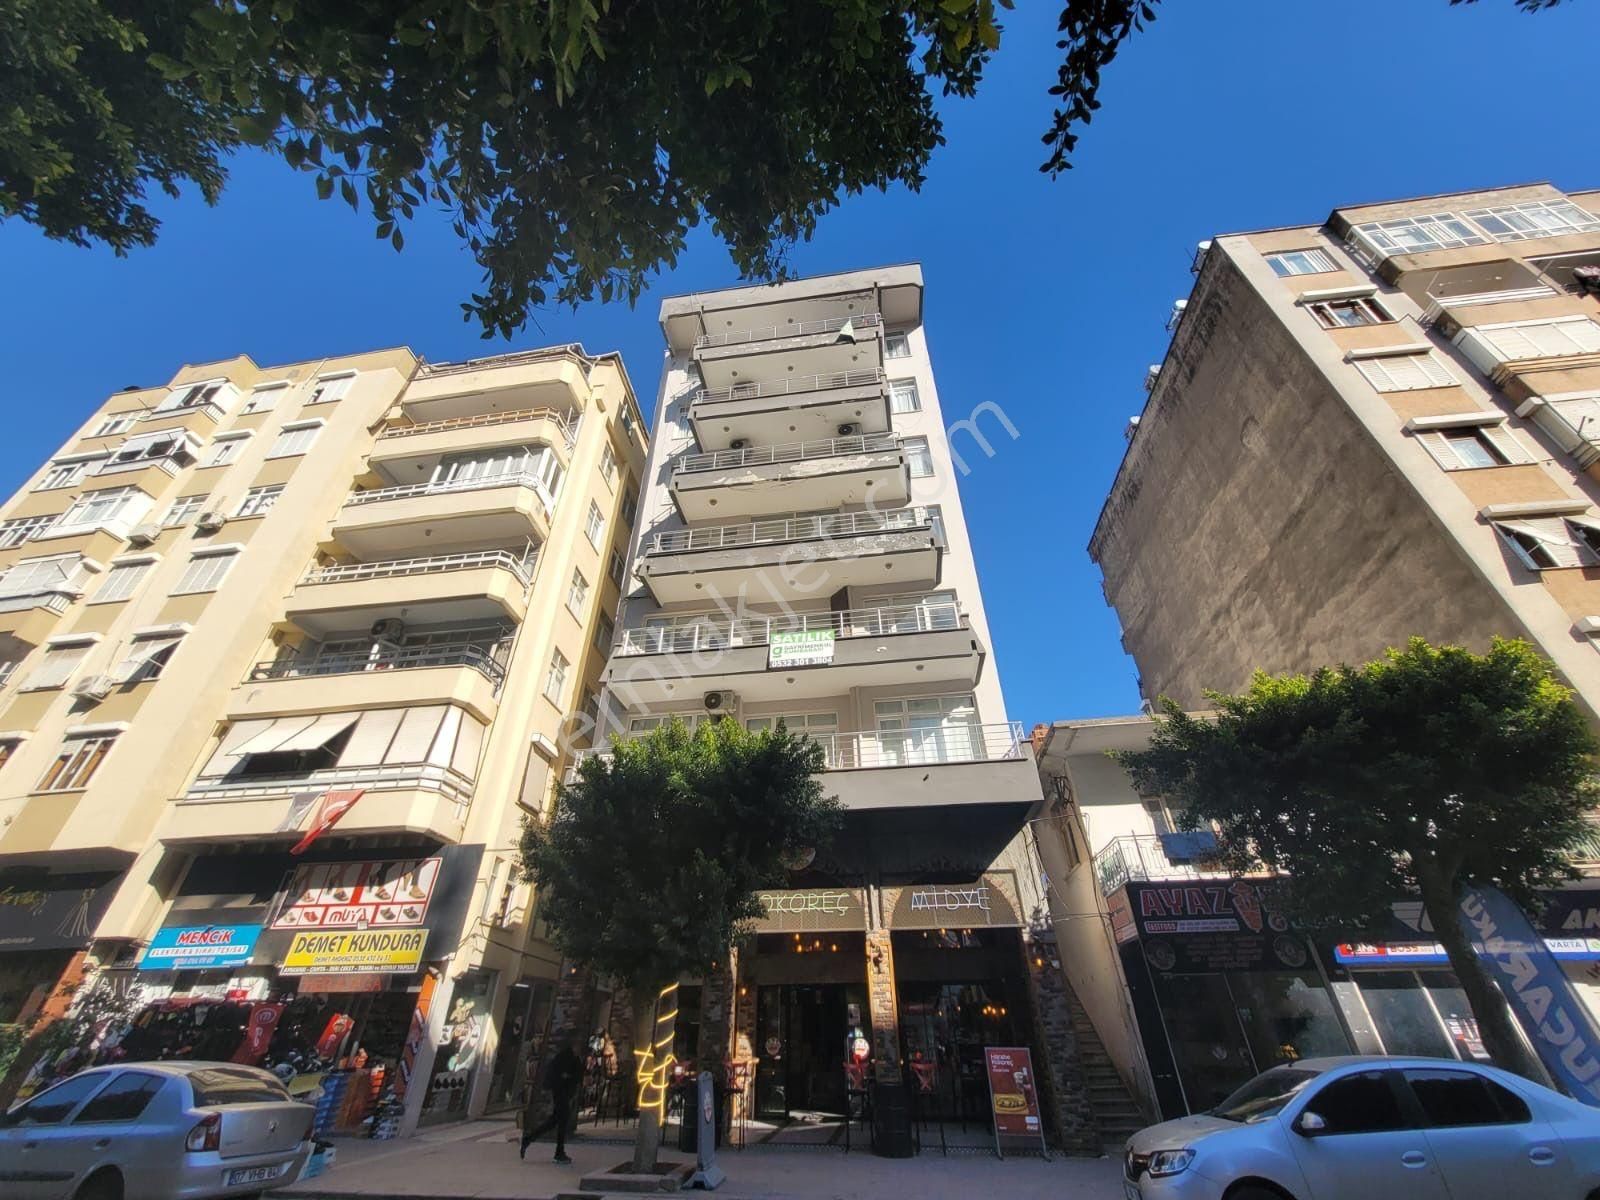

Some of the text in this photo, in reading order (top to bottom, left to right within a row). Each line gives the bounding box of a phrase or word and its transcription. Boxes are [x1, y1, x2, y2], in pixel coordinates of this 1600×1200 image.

[773, 631, 833, 643] SATILIK
[759, 891, 850, 916] OKOREÇ
[1140, 887, 1234, 916] AYAZ
[294, 933, 422, 954] DEMET KUNDURA
